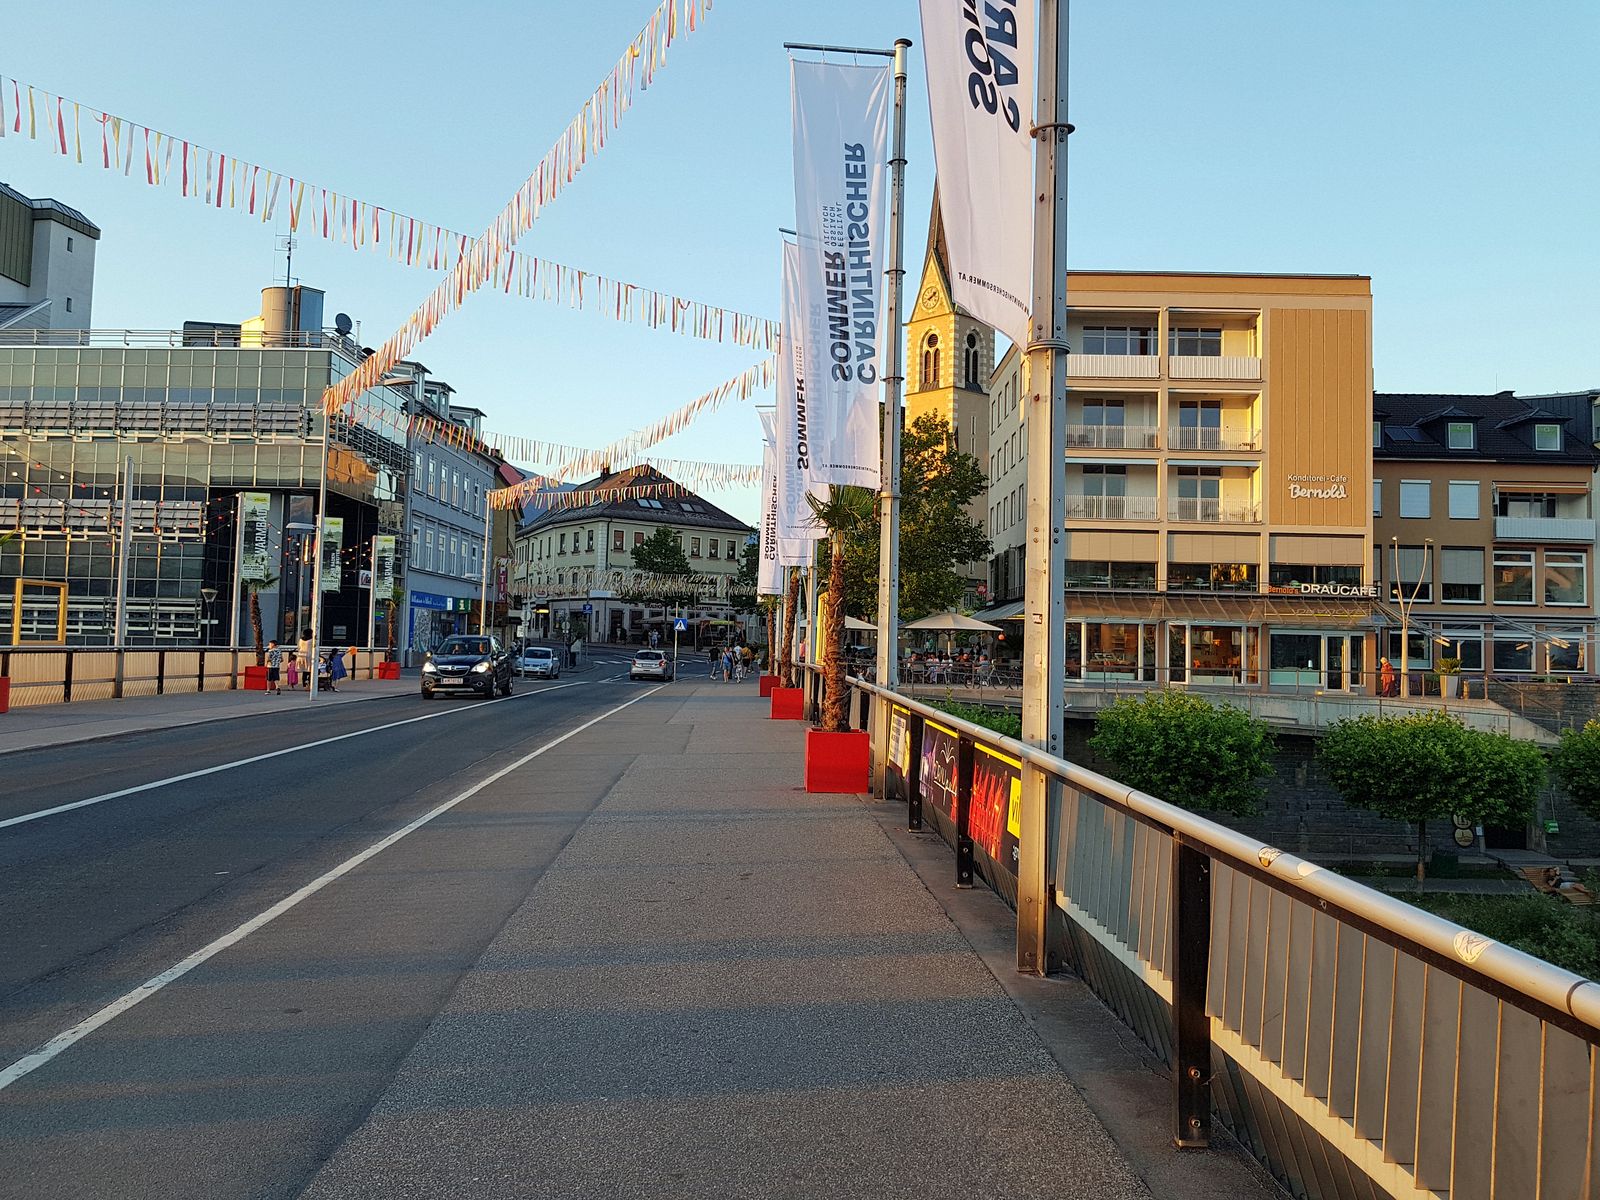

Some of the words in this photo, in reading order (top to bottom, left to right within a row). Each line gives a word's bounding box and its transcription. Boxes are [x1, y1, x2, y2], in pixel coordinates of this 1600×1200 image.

[1288, 482, 1348, 499] Bernold
[254, 508, 268, 557] WARMBAD
[1301, 583, 1378, 597] DRAUCAFE
